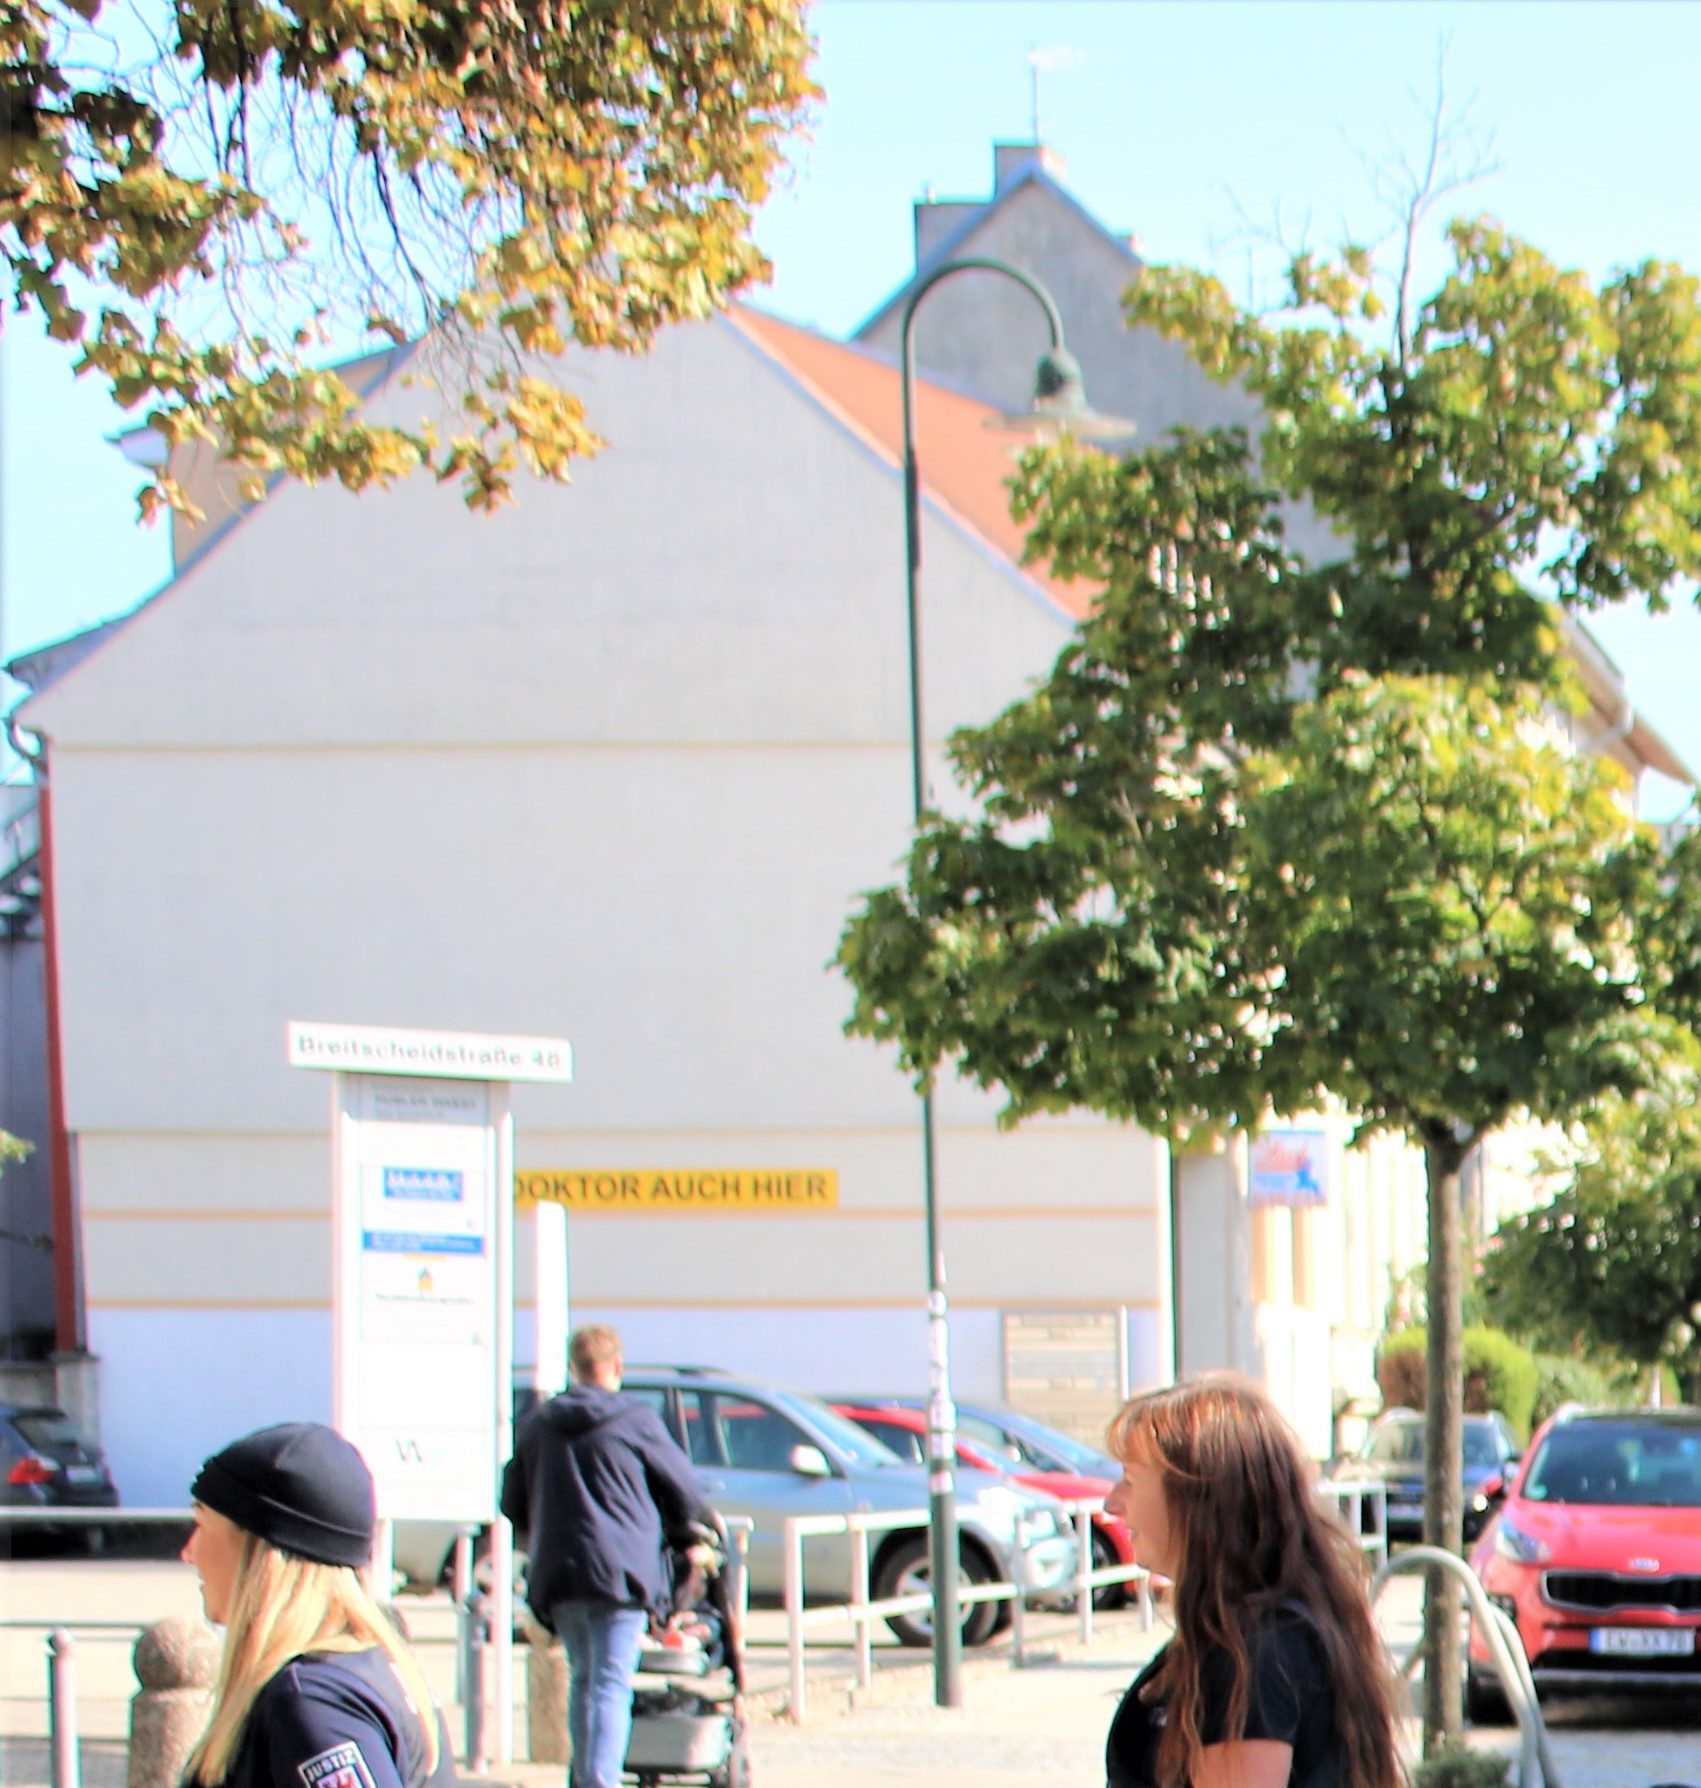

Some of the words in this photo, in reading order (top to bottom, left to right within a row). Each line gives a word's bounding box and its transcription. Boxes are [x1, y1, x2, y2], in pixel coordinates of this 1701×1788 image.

[298, 1034, 523, 1066] Breitscheidstraße
[650, 1174, 741, 1199] AUCH
[753, 1175, 827, 1199] HIER
[305, 1748, 358, 1783] JUSTIZ
